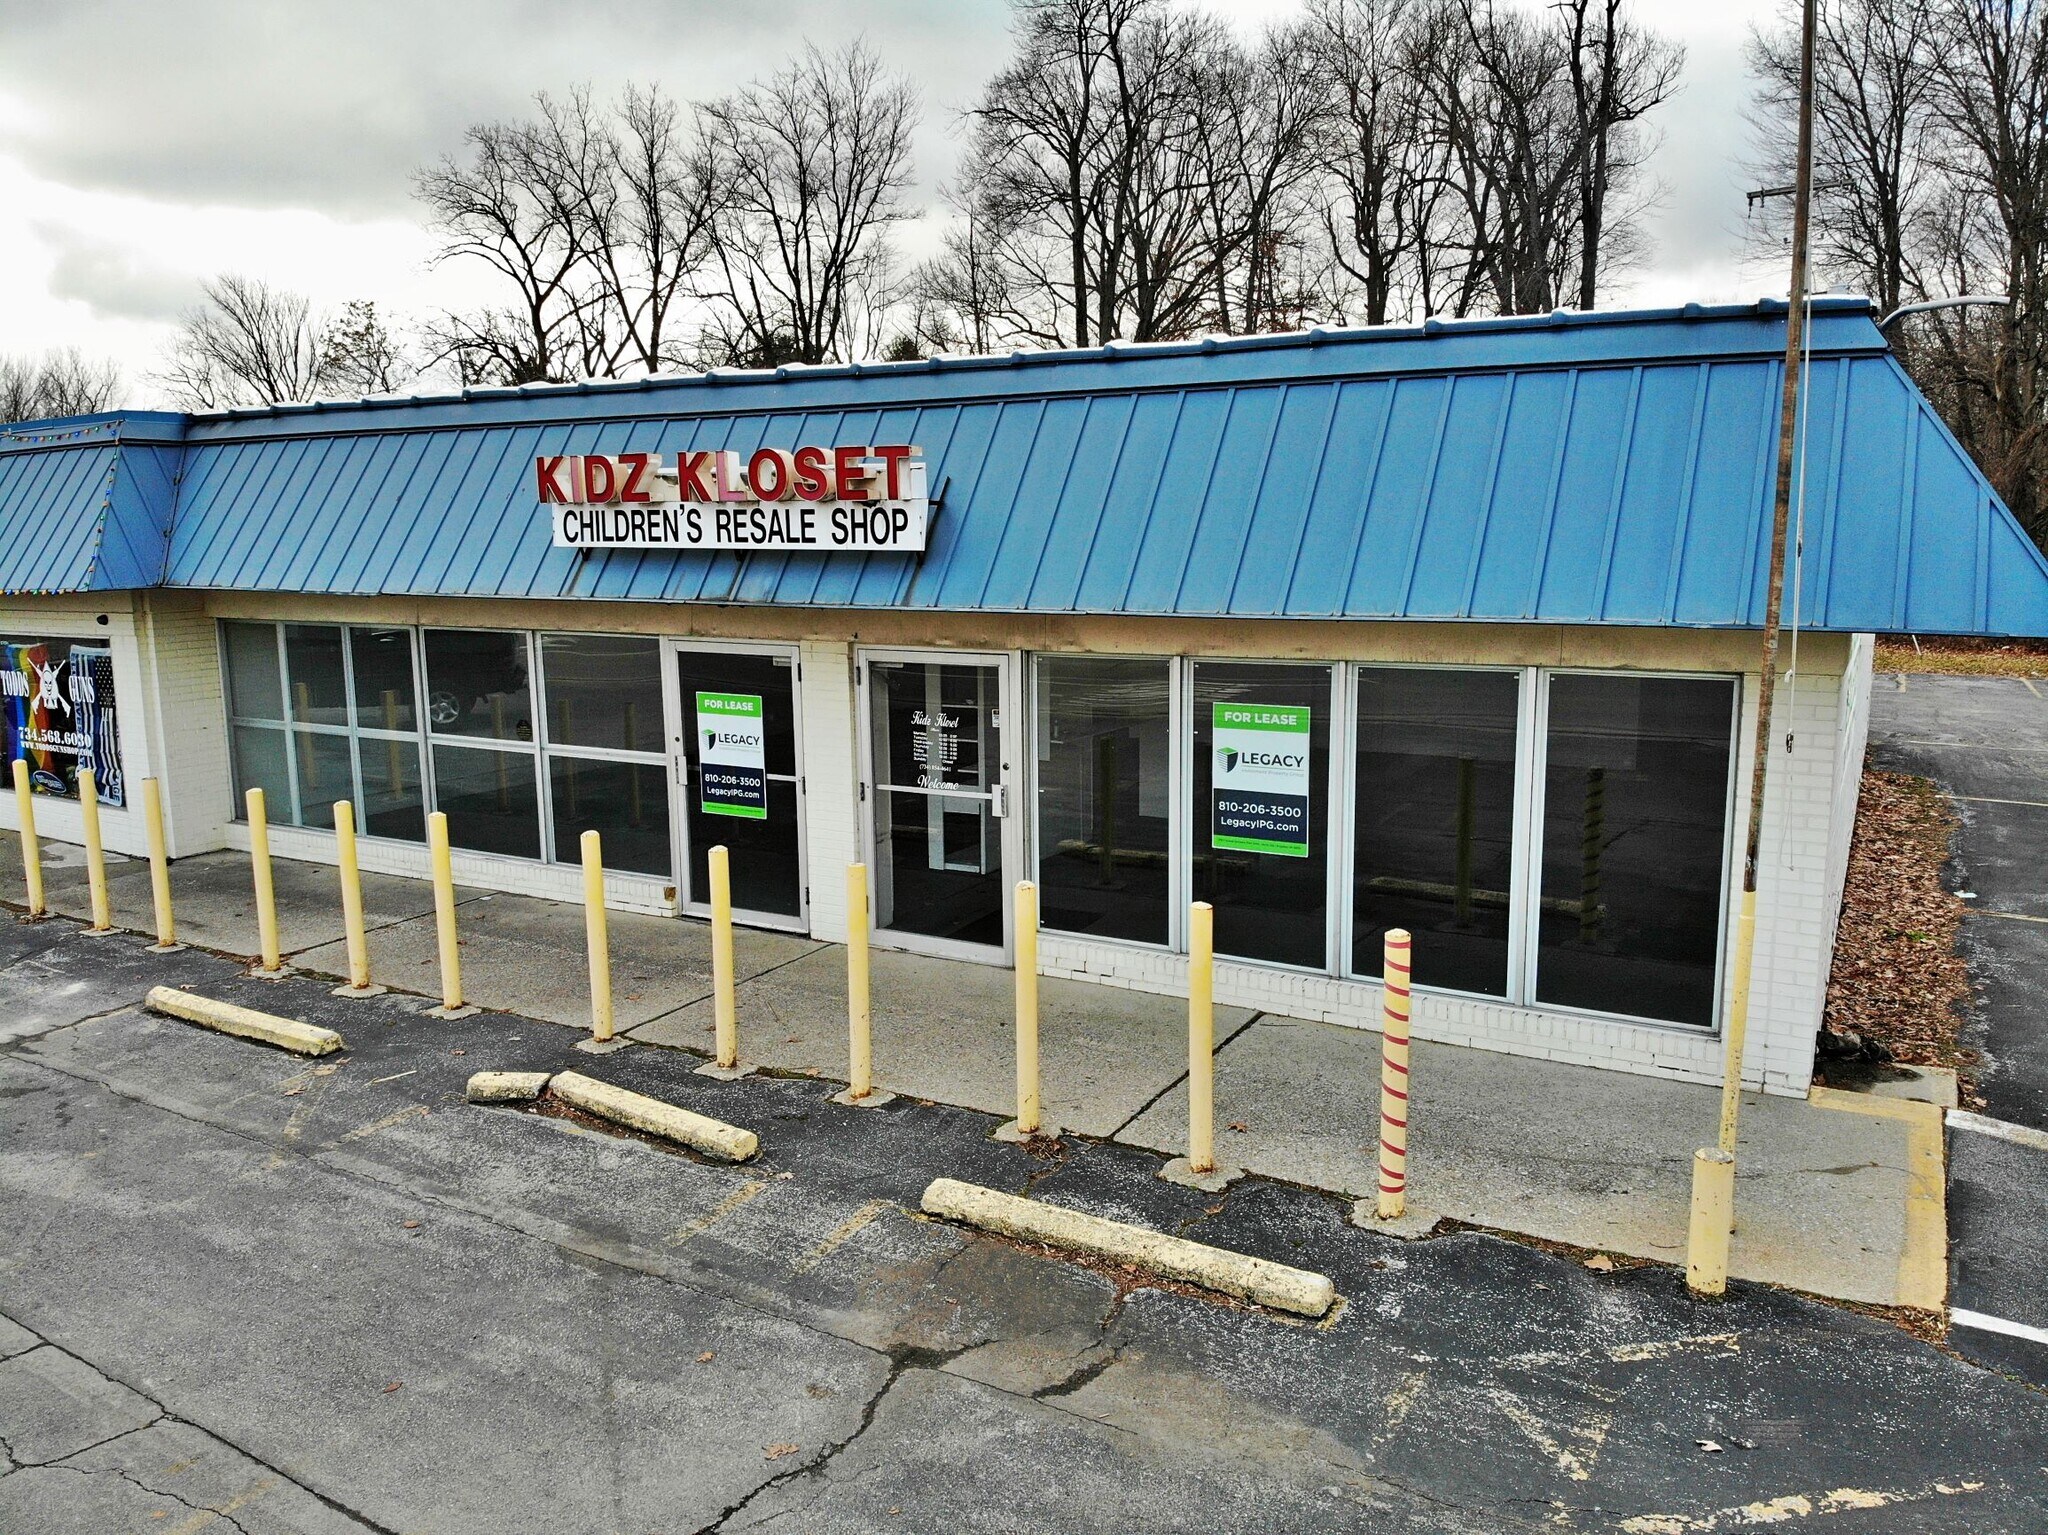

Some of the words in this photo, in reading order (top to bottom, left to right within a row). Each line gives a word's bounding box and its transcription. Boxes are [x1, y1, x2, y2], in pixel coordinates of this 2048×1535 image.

[536, 452, 654, 504] KIDZ
[677, 445, 912, 502] KLOSET
[563, 504, 702, 543] CHILDREN'S
[716, 508, 816, 543] RESALE
[831, 507, 909, 544] SHOP
[0, 670, 30, 697] TODDS
[69, 675, 95, 703] GUNS
[704, 699, 723, 709] FOR
[725, 701, 754, 711] LEASE
[910, 710, 932, 726] Kidz
[934, 713, 959, 728] Kloset
[1224, 711, 1251, 723] FOR
[1254, 713, 1297, 726] LEASE
[18, 726, 92, 748] 734.568.6030
[718, 733, 760, 746] LEGACY
[1241, 752, 1304, 768] LEGACY
[704, 773, 761, 787] 810-206-3500
[917, 775, 960, 790] Welcome
[707, 786, 760, 799] LegacyIPG.com
[1218, 801, 1301, 818] 810-206-3500
[1220, 816, 1299, 832] LegacyIPG.com
